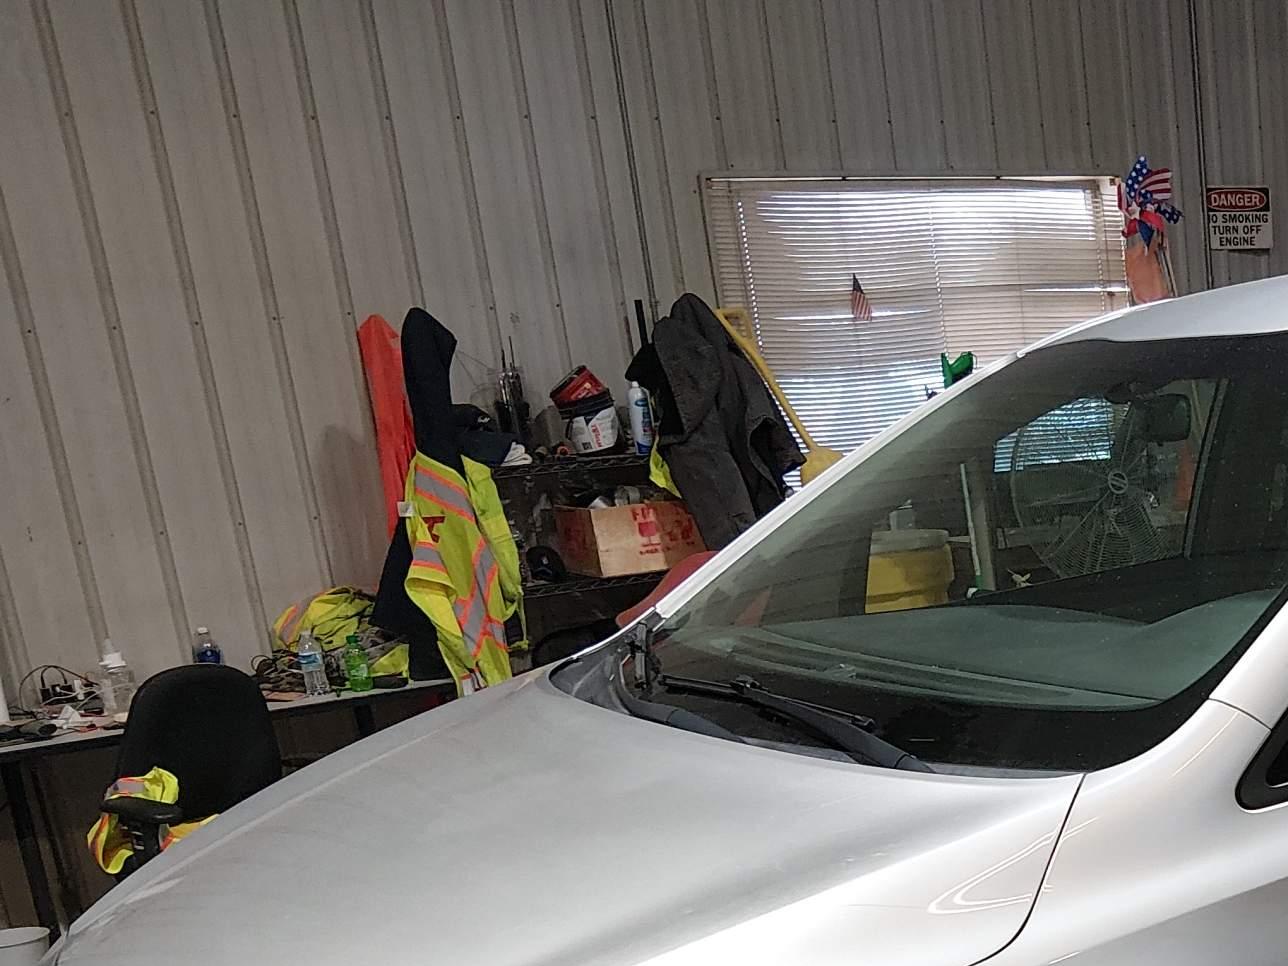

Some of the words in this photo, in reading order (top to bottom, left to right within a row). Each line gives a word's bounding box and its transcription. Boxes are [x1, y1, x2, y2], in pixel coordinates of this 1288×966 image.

[1211, 194, 1260, 206] DANGER
[1210, 213, 1218, 224] O
[1221, 213, 1269, 224] SMOKING
[1211, 225, 1239, 236] TURN
[1242, 224, 1262, 235] OFF
[1219, 237, 1256, 246] ENGINE
